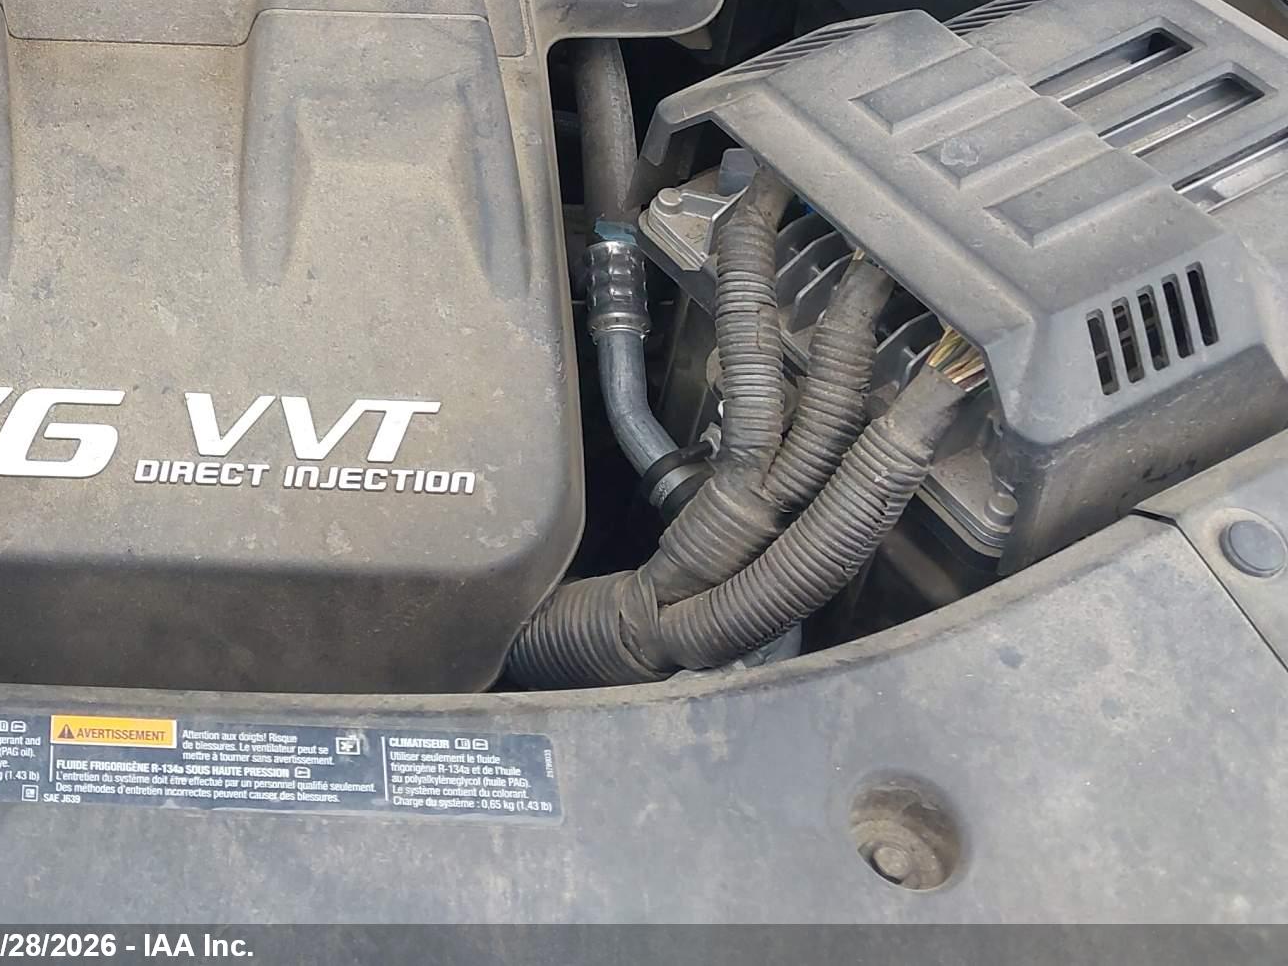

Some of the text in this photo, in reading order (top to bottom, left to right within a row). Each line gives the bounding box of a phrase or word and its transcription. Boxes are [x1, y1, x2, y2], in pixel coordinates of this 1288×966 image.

[184, 391, 442, 463] VVT
[134, 459, 477, 495] DIRECT INJECTION
[25, 736, 41, 746] and
[76, 728, 166, 741] AVERTISSEMENT
[182, 729, 220, 740] Attention
[238, 732, 267, 743] doigts!
[268, 733, 298, 744] Risque
[182, 740, 329, 755] de blessures. Le ventilateur peut se
[388, 737, 450, 749] CLIMATISEUR
[0, 747, 19, 757] (PAG
[20, 748, 36, 758] oil).
[182, 752, 335, 766] mettre à tourner sans avertissement.
[390, 751, 501, 764] Utiliser seulement le fluide
[56, 759, 290, 778] FLUIDE FRIGORIGÈNE R-134a SOUS HAUTE PRESSION
[390, 762, 521, 776] frigorigène R-134a et de l'huile
[4, 770, 27, 781] (1.43
[28, 771, 40, 782] lb)
[56, 771, 376, 793] L'entretien du système doit être effectué par un personnel qualifié seulement.
[391, 774, 403, 783] au
[482, 777, 506, 787] (huile
[508, 777, 532, 789] PAG).
[43, 793, 60, 803] SAE
[60, 794, 81, 804] J639
[55, 782, 340, 803] Des méthodes d'entretien incorrectes peuvent causer des blessures.
[392, 785, 529, 799] Le système contient du colorant.
[393, 796, 424, 807] Charge
[425, 797, 437, 807] du
[438, 798, 475, 809] système
[503, 800, 515, 812] kg
[540, 802, 553, 813] lb)
